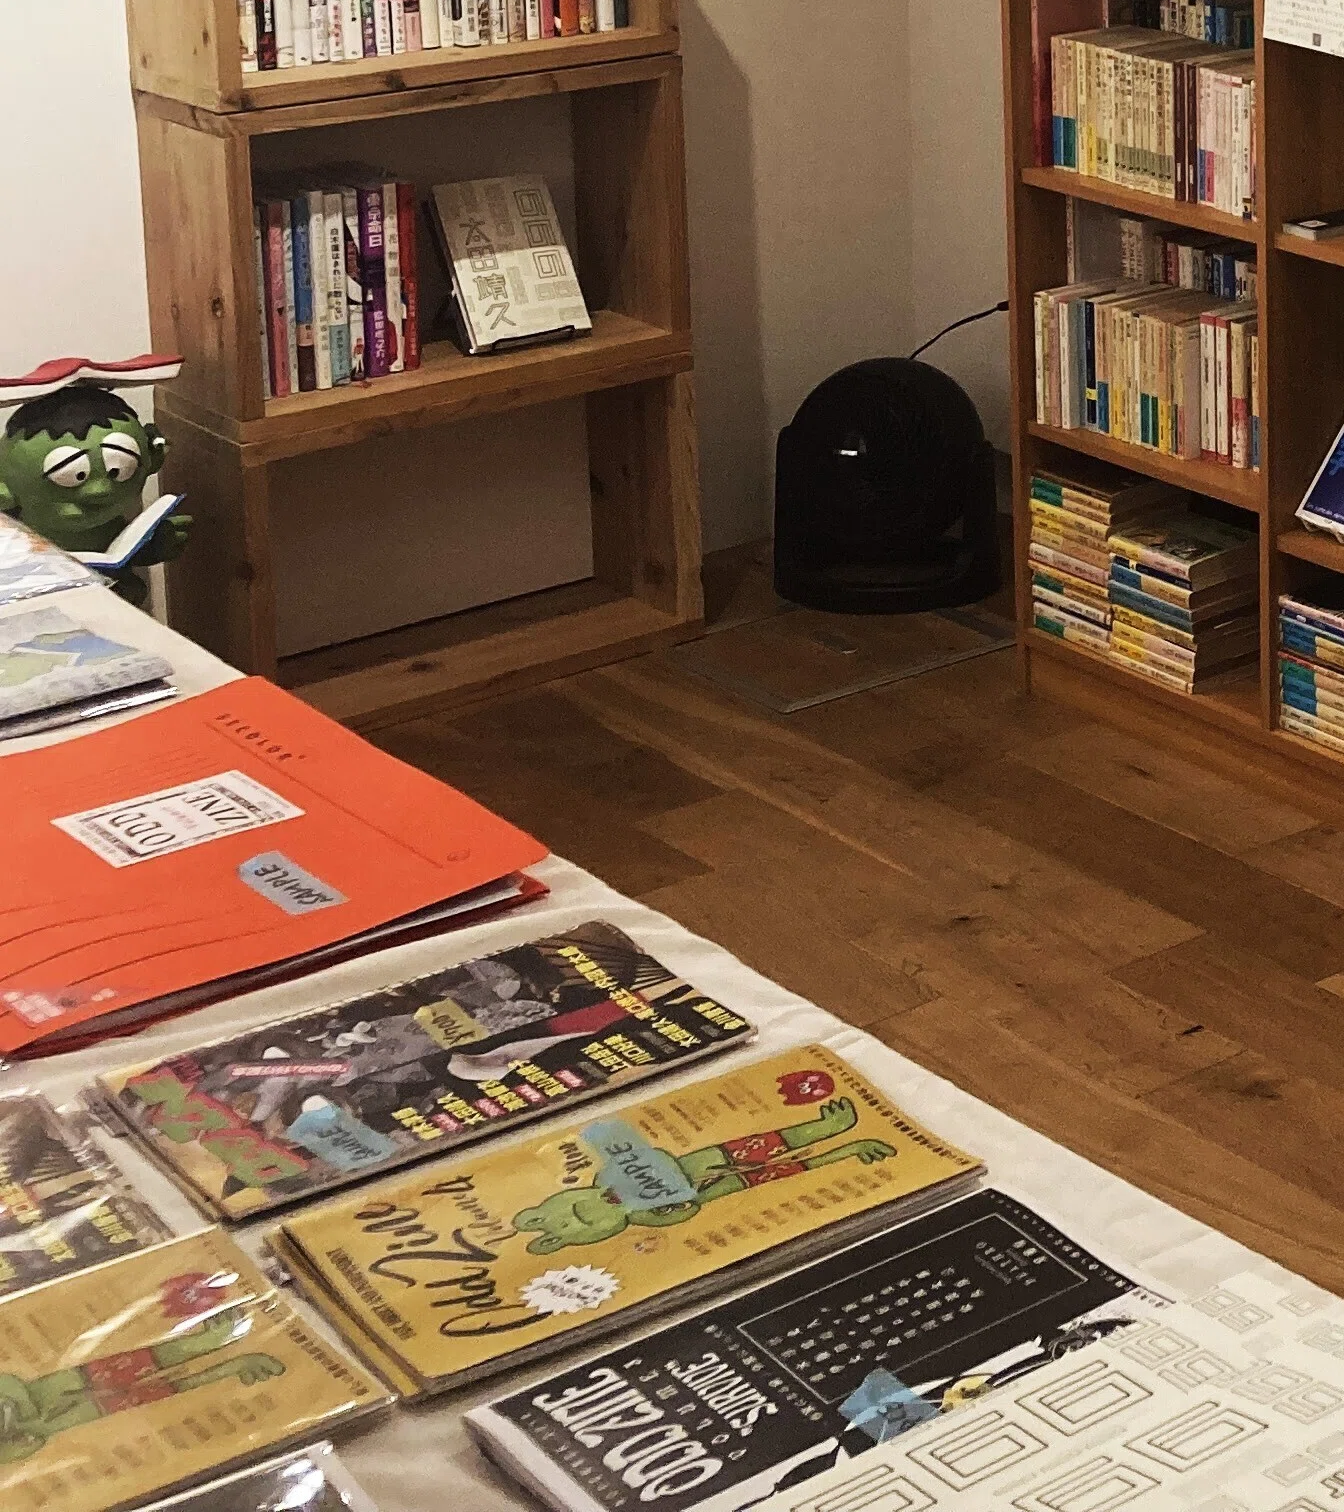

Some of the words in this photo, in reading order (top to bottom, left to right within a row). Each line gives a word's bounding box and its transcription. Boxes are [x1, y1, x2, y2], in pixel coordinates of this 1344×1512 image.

[458, 218, 517, 331] 太田靖久
[108, 809, 179, 855] ODD
[185, 787, 252, 829] ZINE
[256, 861, 334, 907] SAMPLE
[604, 1141, 679, 1201] SAMPLE
[353, 1204, 497, 1289] Zine
[420, 1265, 553, 1340] Odd
[532, 1367, 665, 1448] ZINE
[602, 1422, 724, 1502] ODD
